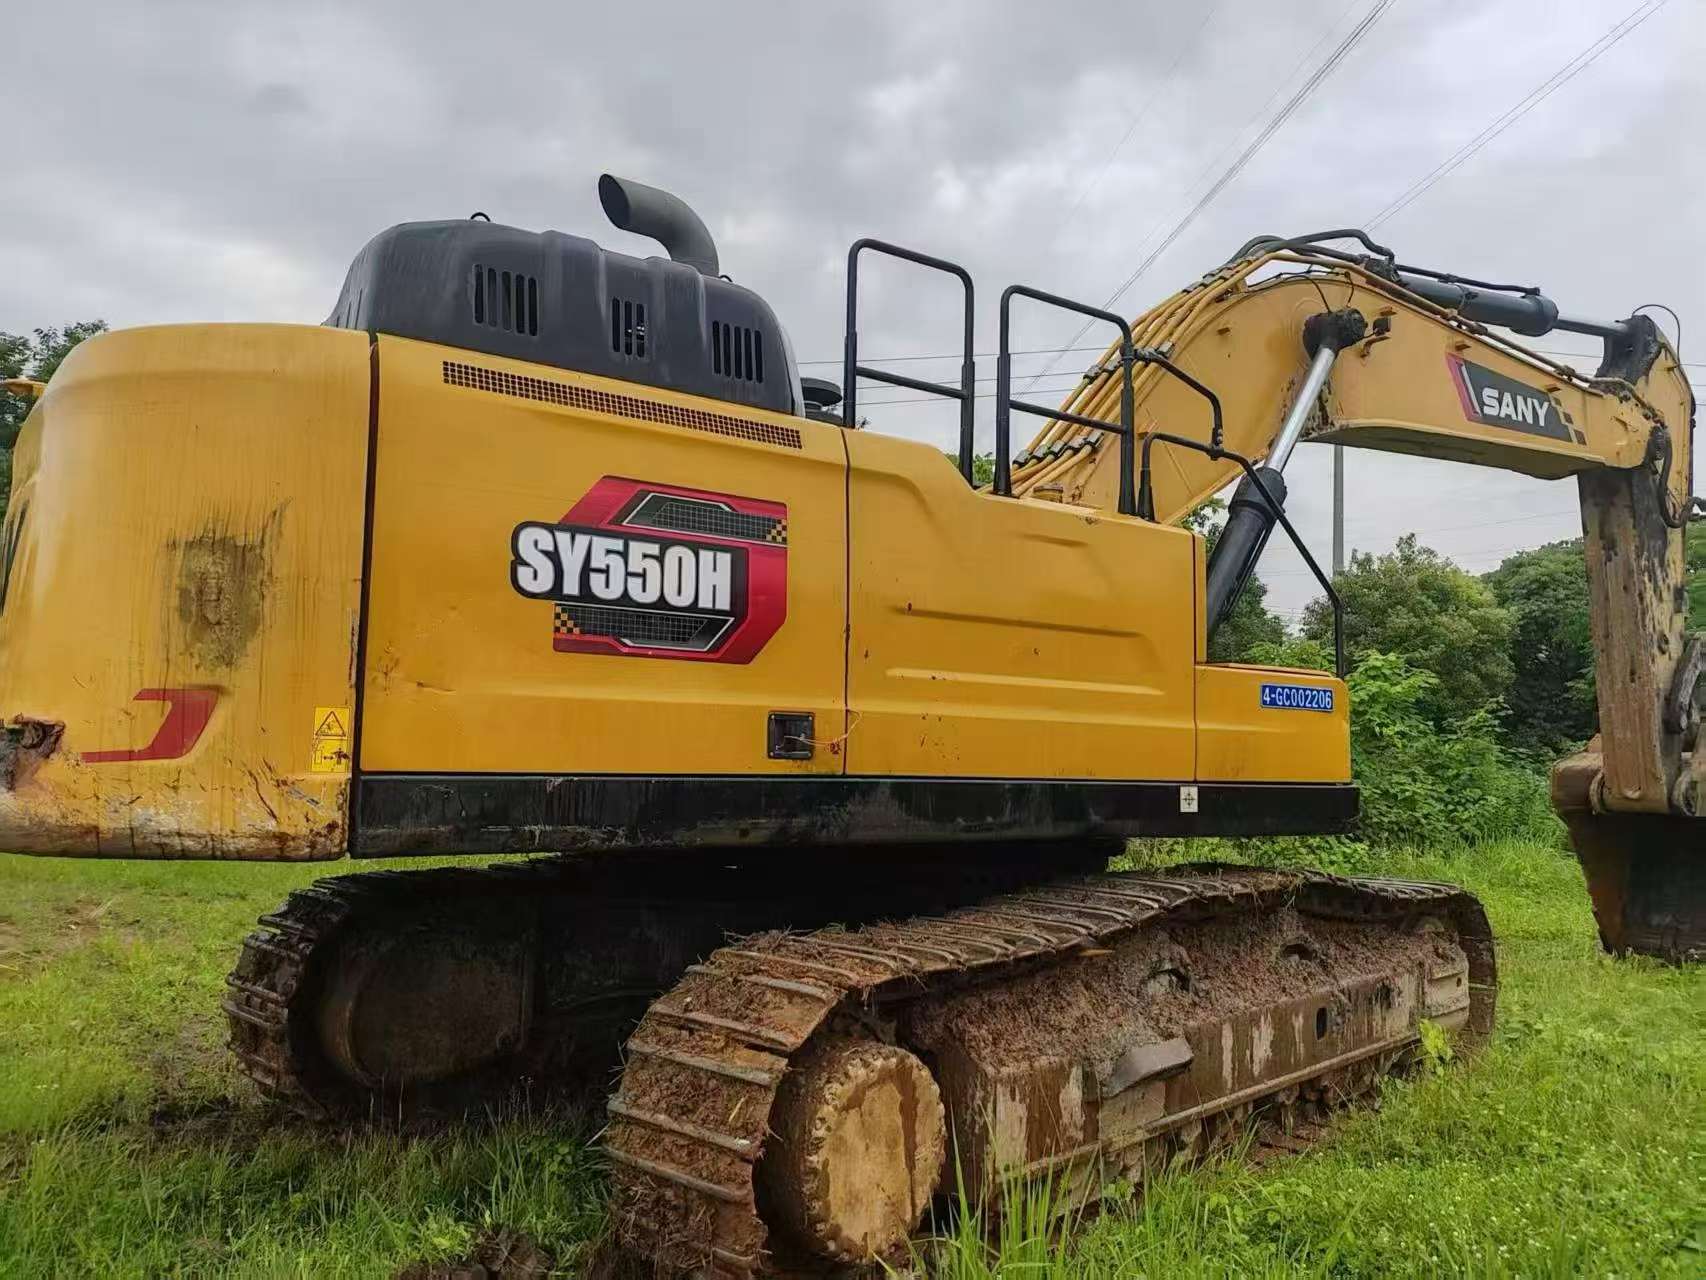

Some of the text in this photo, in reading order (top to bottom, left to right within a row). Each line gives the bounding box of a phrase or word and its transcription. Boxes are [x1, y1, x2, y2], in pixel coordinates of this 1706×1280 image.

[1482, 387, 1550, 427] SANY
[516, 526, 732, 611] SY550H
[1263, 687, 1332, 709] 4-GC002206
